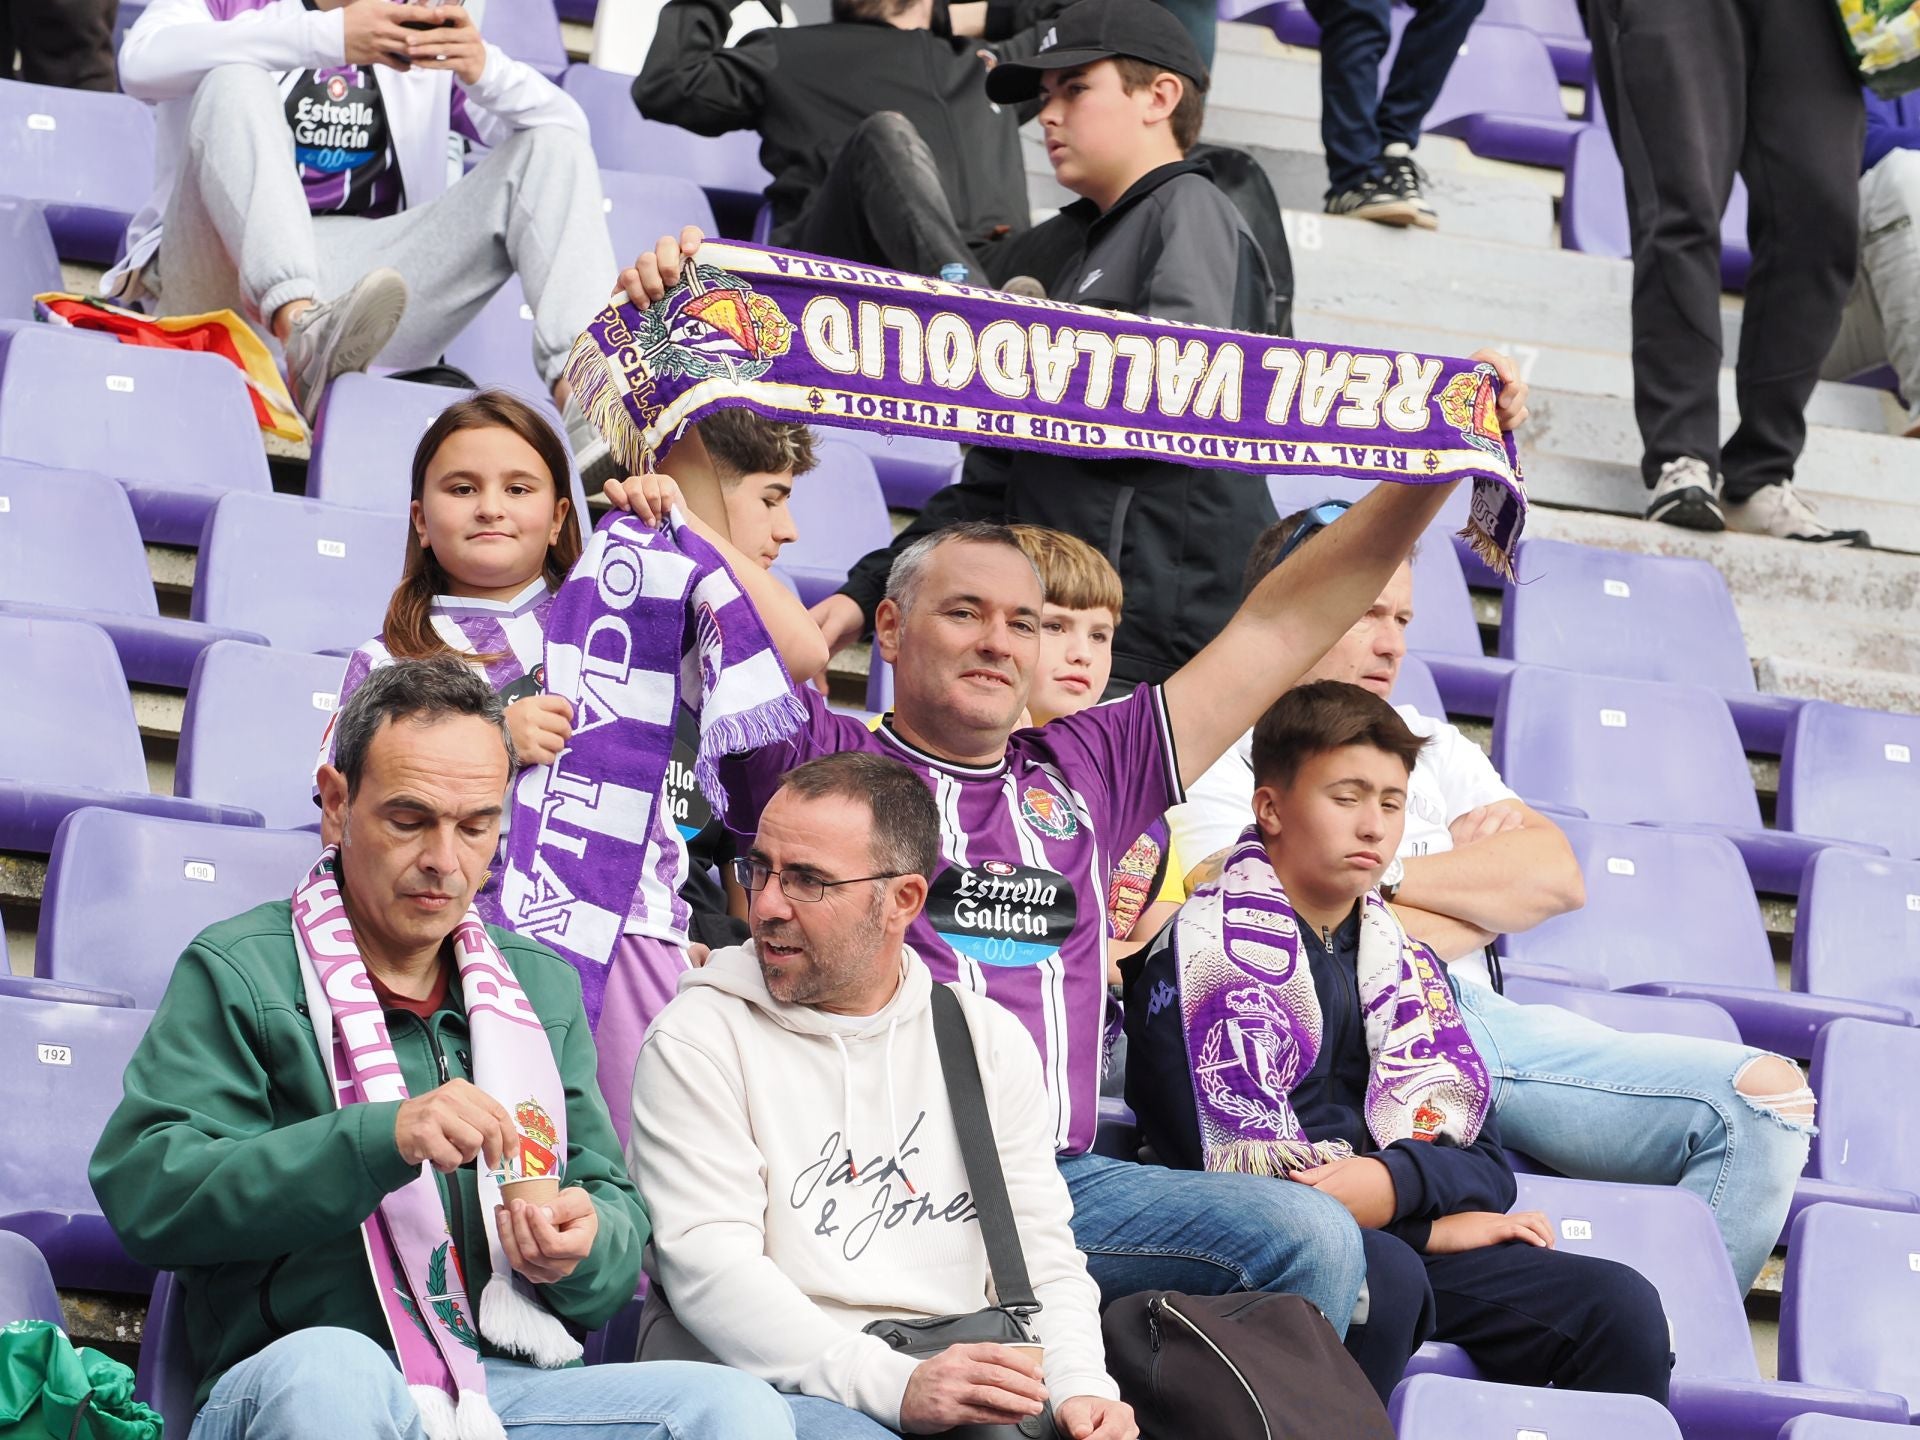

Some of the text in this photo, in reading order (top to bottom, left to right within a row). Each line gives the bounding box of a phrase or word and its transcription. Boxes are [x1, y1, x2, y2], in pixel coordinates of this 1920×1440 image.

[294, 97, 373, 126] Estrella
[295, 120, 369, 149] Galicia
[768, 253, 905, 288] PUCELA
[593, 302, 668, 430] PUCELA
[801, 295, 1443, 433] REAL VALLADOLID
[836, 392, 1408, 470] REAL VALLADOLID CLUB DE FUTBOL
[191, 863, 209, 879] 190
[953, 870, 1057, 907] Estrella
[954, 898, 1048, 937] Galicia
[43, 1047, 67, 1062] 192
[790, 1111, 926, 1209] Jack
[814, 1197, 840, 1237] &
[1566, 1225, 1587, 1238] 184
